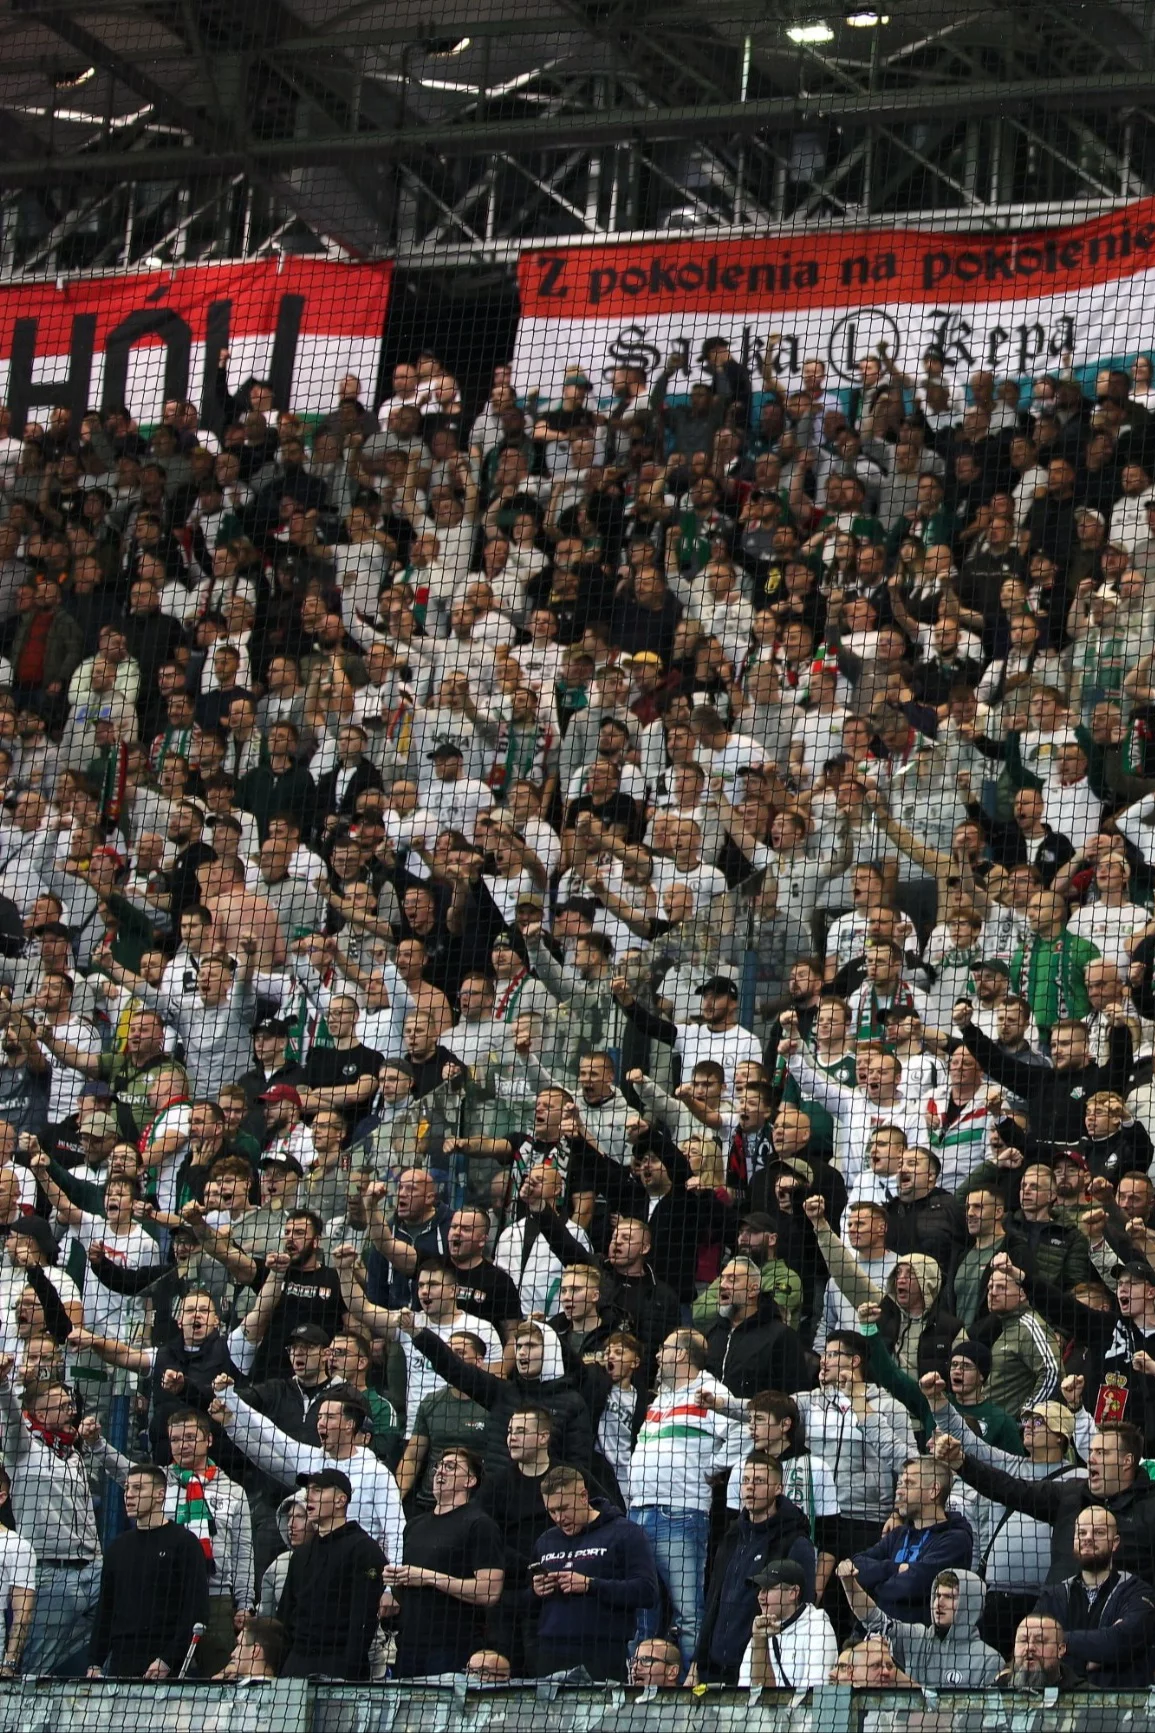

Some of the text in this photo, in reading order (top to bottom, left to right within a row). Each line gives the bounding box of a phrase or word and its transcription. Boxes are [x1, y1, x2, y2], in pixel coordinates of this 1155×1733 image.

[536, 256, 569, 298] Z
[589, 251, 818, 306] pokolenia
[839, 250, 897, 287] na
[601, 324, 801, 381] Saka
